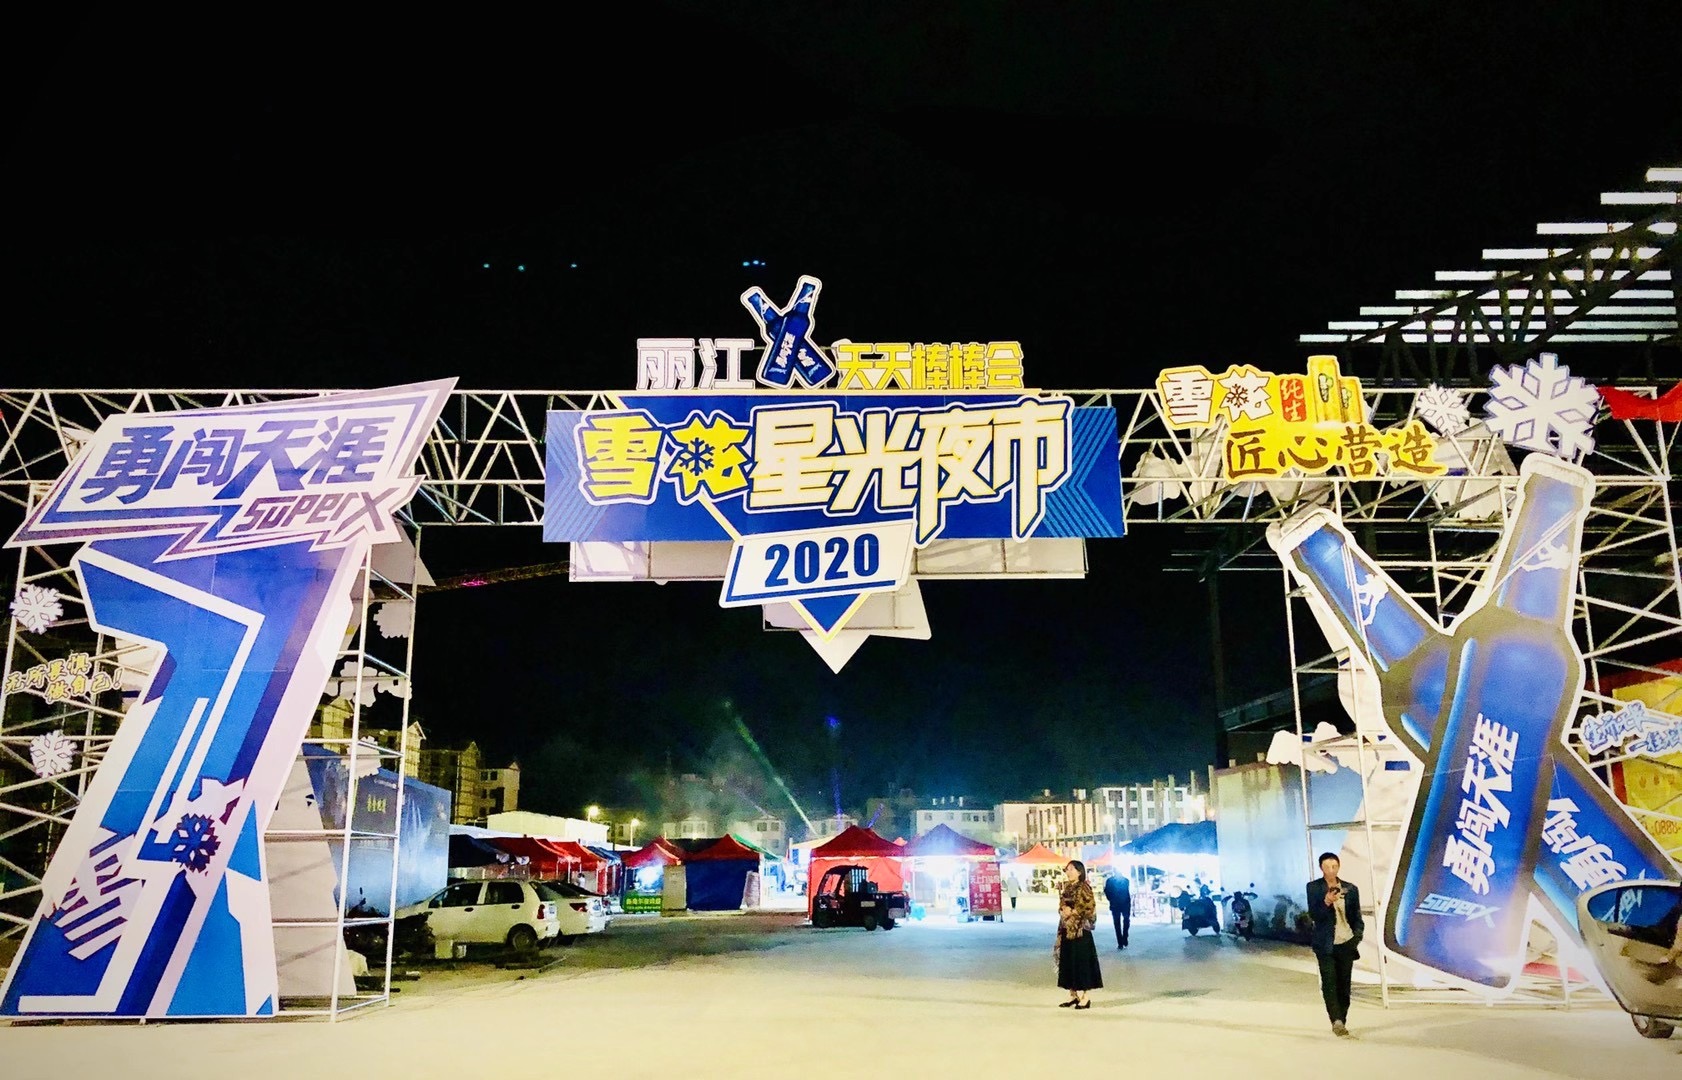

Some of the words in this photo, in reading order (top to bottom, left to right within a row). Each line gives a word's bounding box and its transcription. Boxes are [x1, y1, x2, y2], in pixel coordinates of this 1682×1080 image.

[637, 338, 755, 390] 丽江
[835, 340, 1024, 390] 天天棒棒会
[1160, 368, 1274, 424] 雪花
[1279, 378, 1305, 423] 纯生
[80, 415, 396, 505] 勇闯天涯
[1226, 424, 1449, 480] 匠心营造
[764, 532, 880, 588] 2020
[1442, 712, 1519, 896] 勇闯天涯
[1541, 797, 1628, 891] 勇闯
